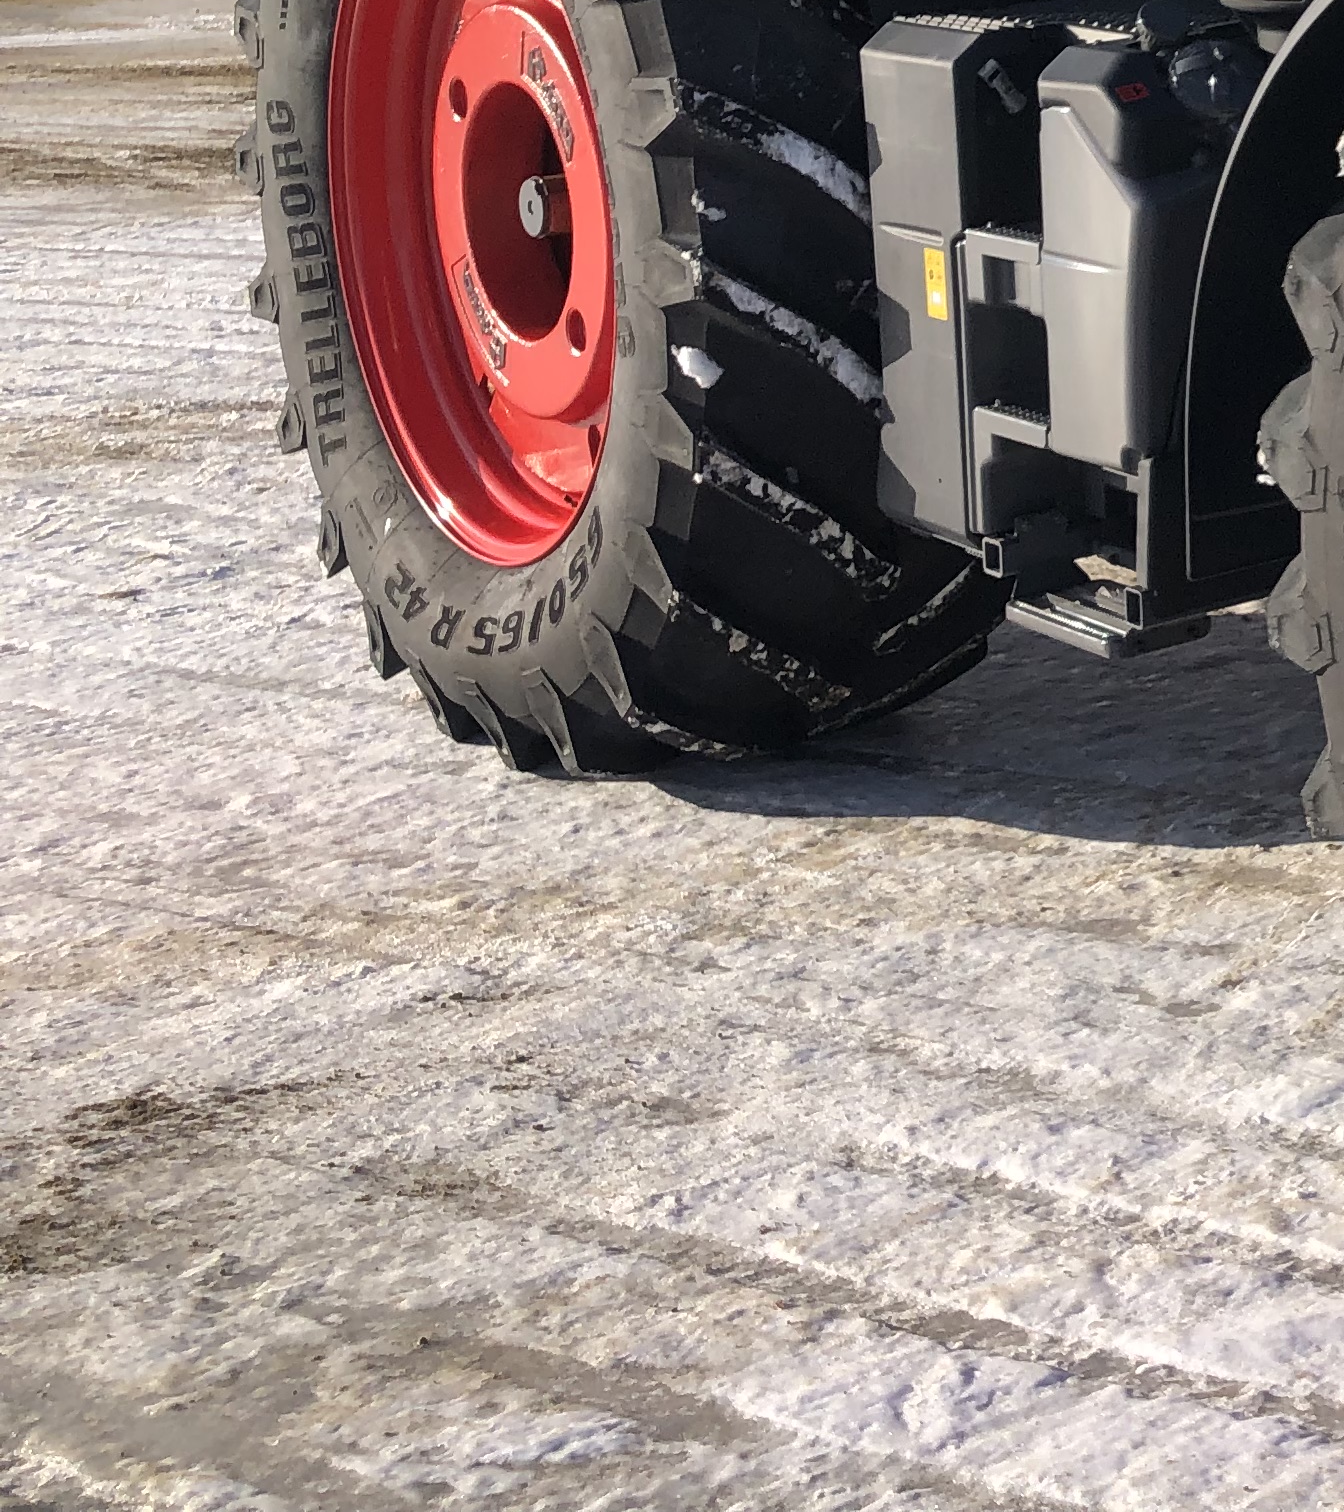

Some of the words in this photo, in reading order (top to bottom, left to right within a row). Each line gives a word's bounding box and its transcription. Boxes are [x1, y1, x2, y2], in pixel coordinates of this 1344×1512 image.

[266, 99, 348, 468] TRELLEBORG
[384, 560, 430, 623] 42
[430, 603, 467, 650] R
